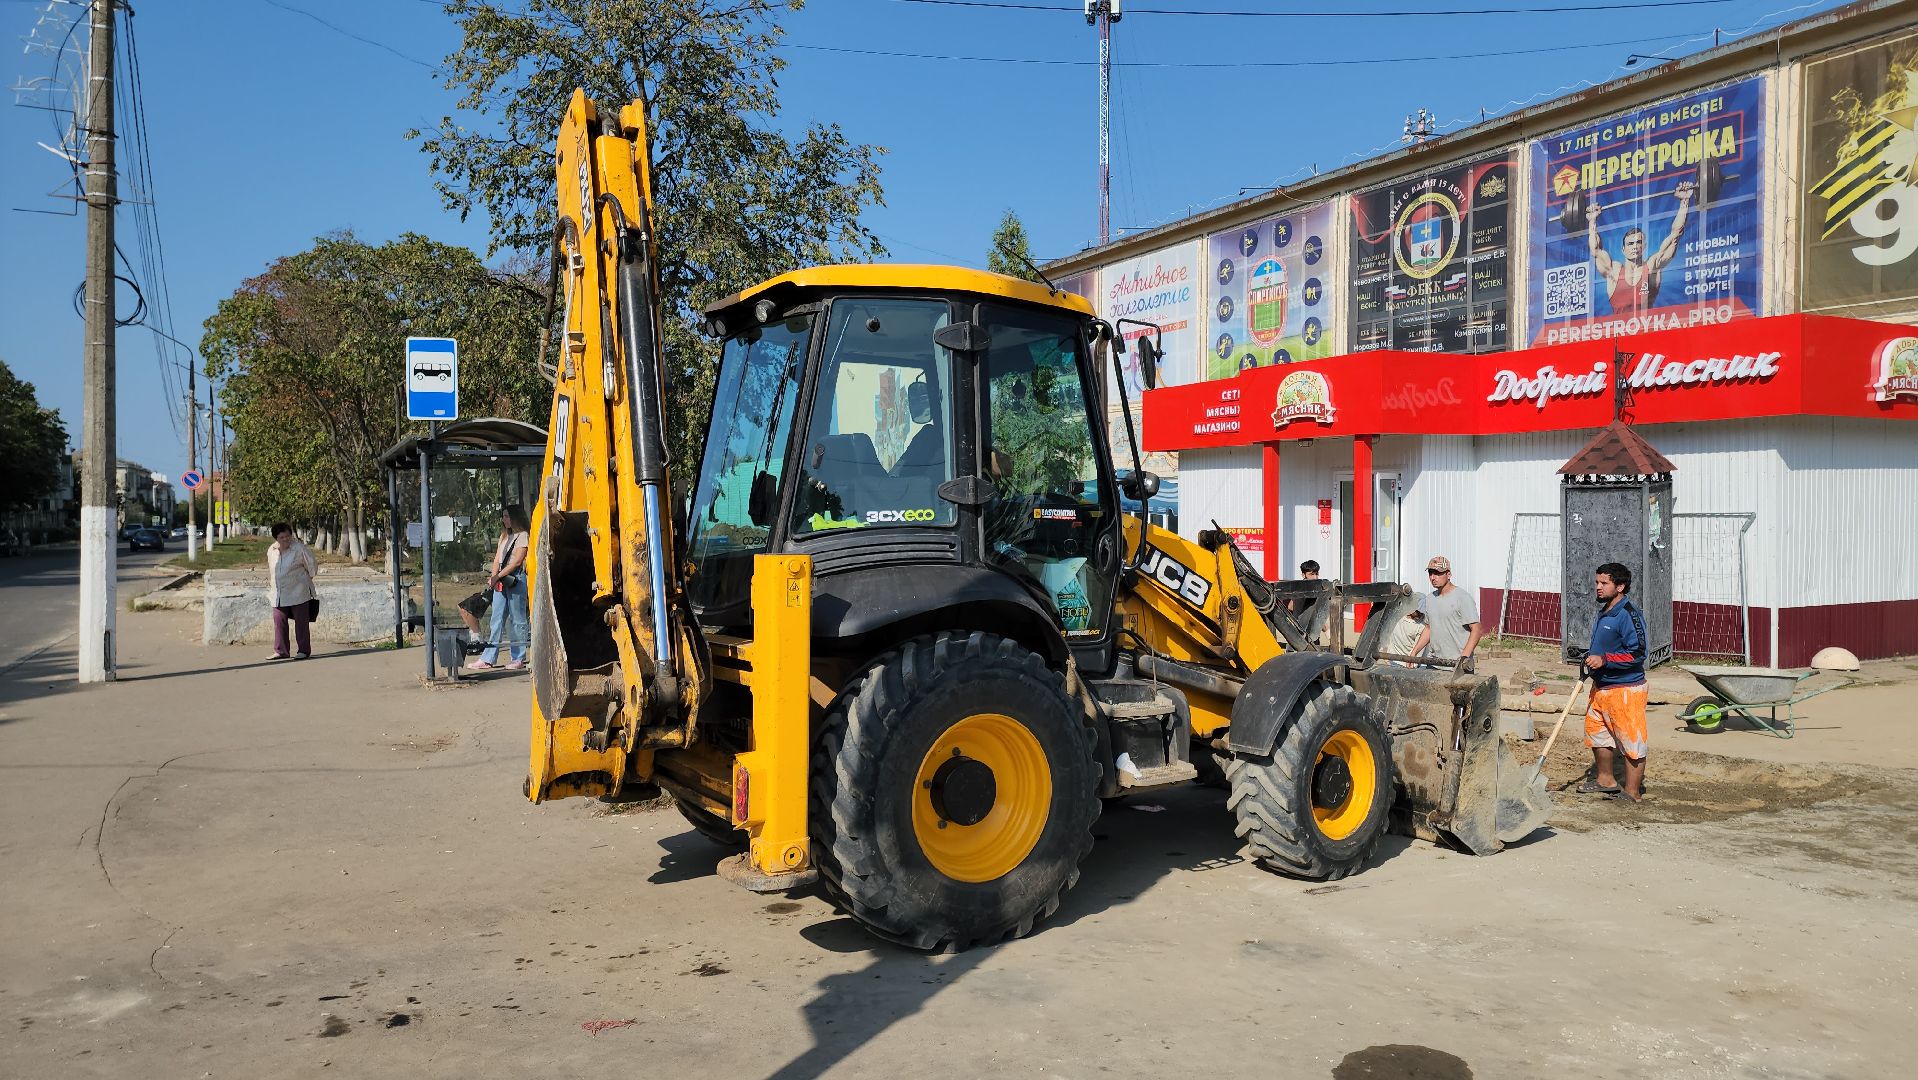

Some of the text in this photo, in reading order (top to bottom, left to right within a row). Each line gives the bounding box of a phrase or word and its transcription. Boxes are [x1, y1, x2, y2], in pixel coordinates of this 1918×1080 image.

[1559, 96, 1723, 155] 17 ЛЕТ С ВАМИ ВМЕСТЕ!
[1581, 125, 1736, 190] ПЕРЕСТРОЙКА
[1685, 234, 1739, 253] К НОВЫМ
[1685, 249, 1740, 267] ПОБЕДАМ
[1109, 264, 1188, 300] Активное
[1474, 269, 1491, 280] ВАШ
[1685, 263, 1739, 282] В ТРУДЕ И
[1684, 279, 1731, 296] СПОРТЕ!
[1547, 304, 1733, 346] PERESTROYKA.PRO
[1487, 352, 1781, 408] Добрый Мясник
[1281, 404, 1321, 418] МЯСНИК
[1140, 550, 1209, 606] JCB
